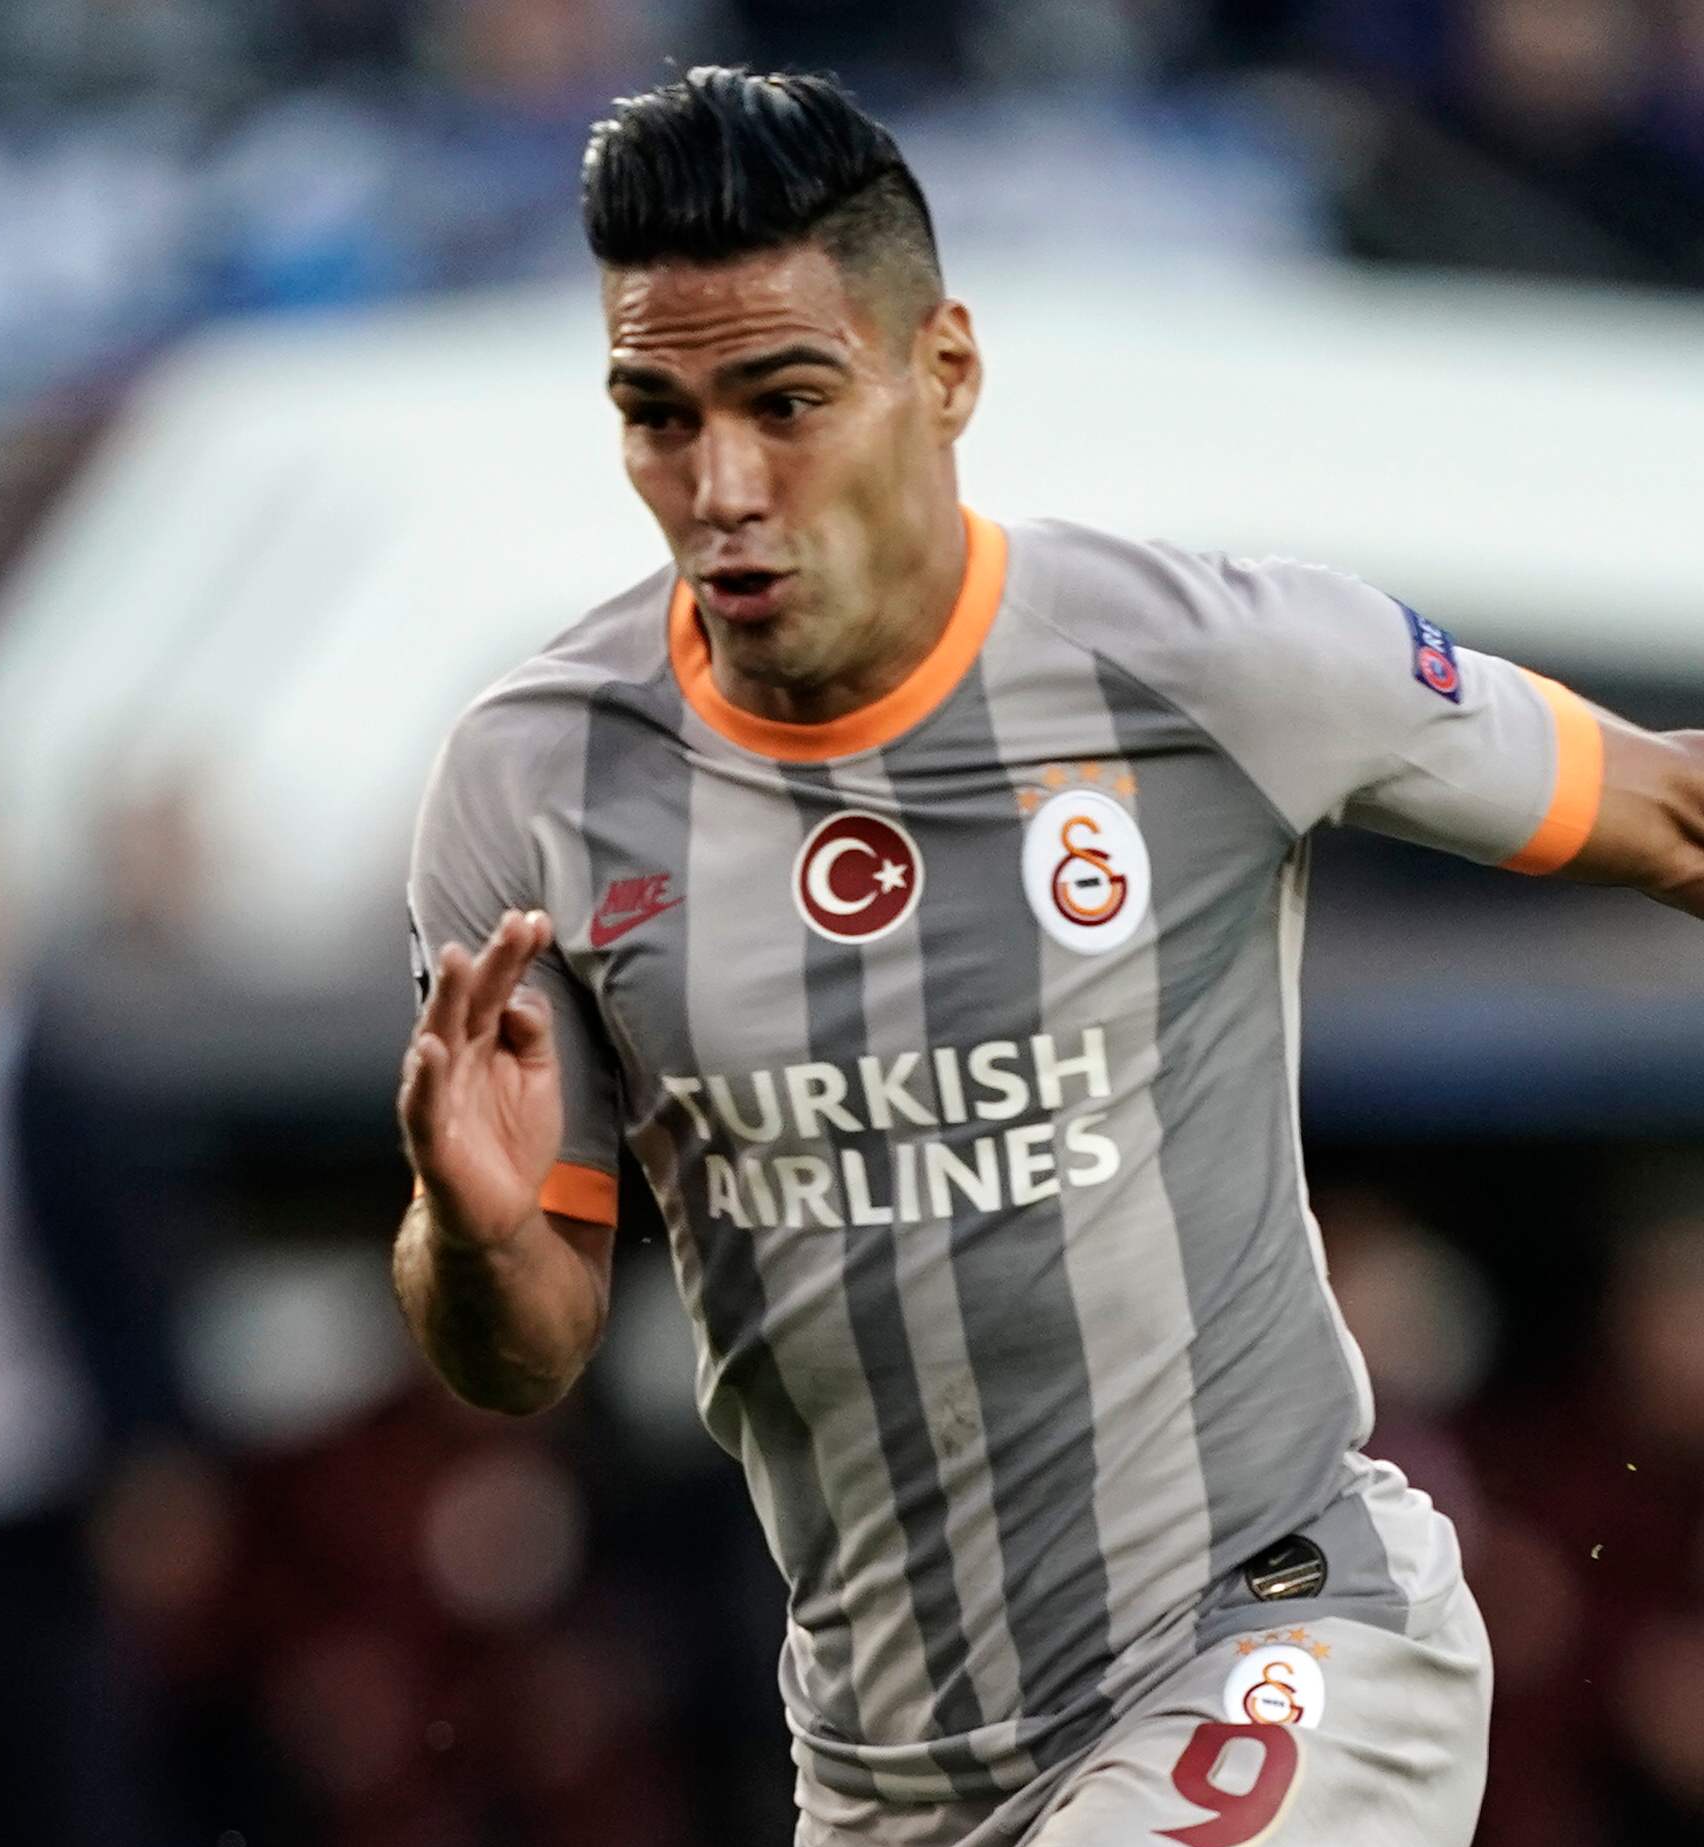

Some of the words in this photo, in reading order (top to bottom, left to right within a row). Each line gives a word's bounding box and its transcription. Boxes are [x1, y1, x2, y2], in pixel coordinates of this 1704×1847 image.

[600, 873, 670, 915] NIKE
[662, 1028, 1111, 1143] TURKISH
[705, 1112, 1121, 1229] AIRLINES
